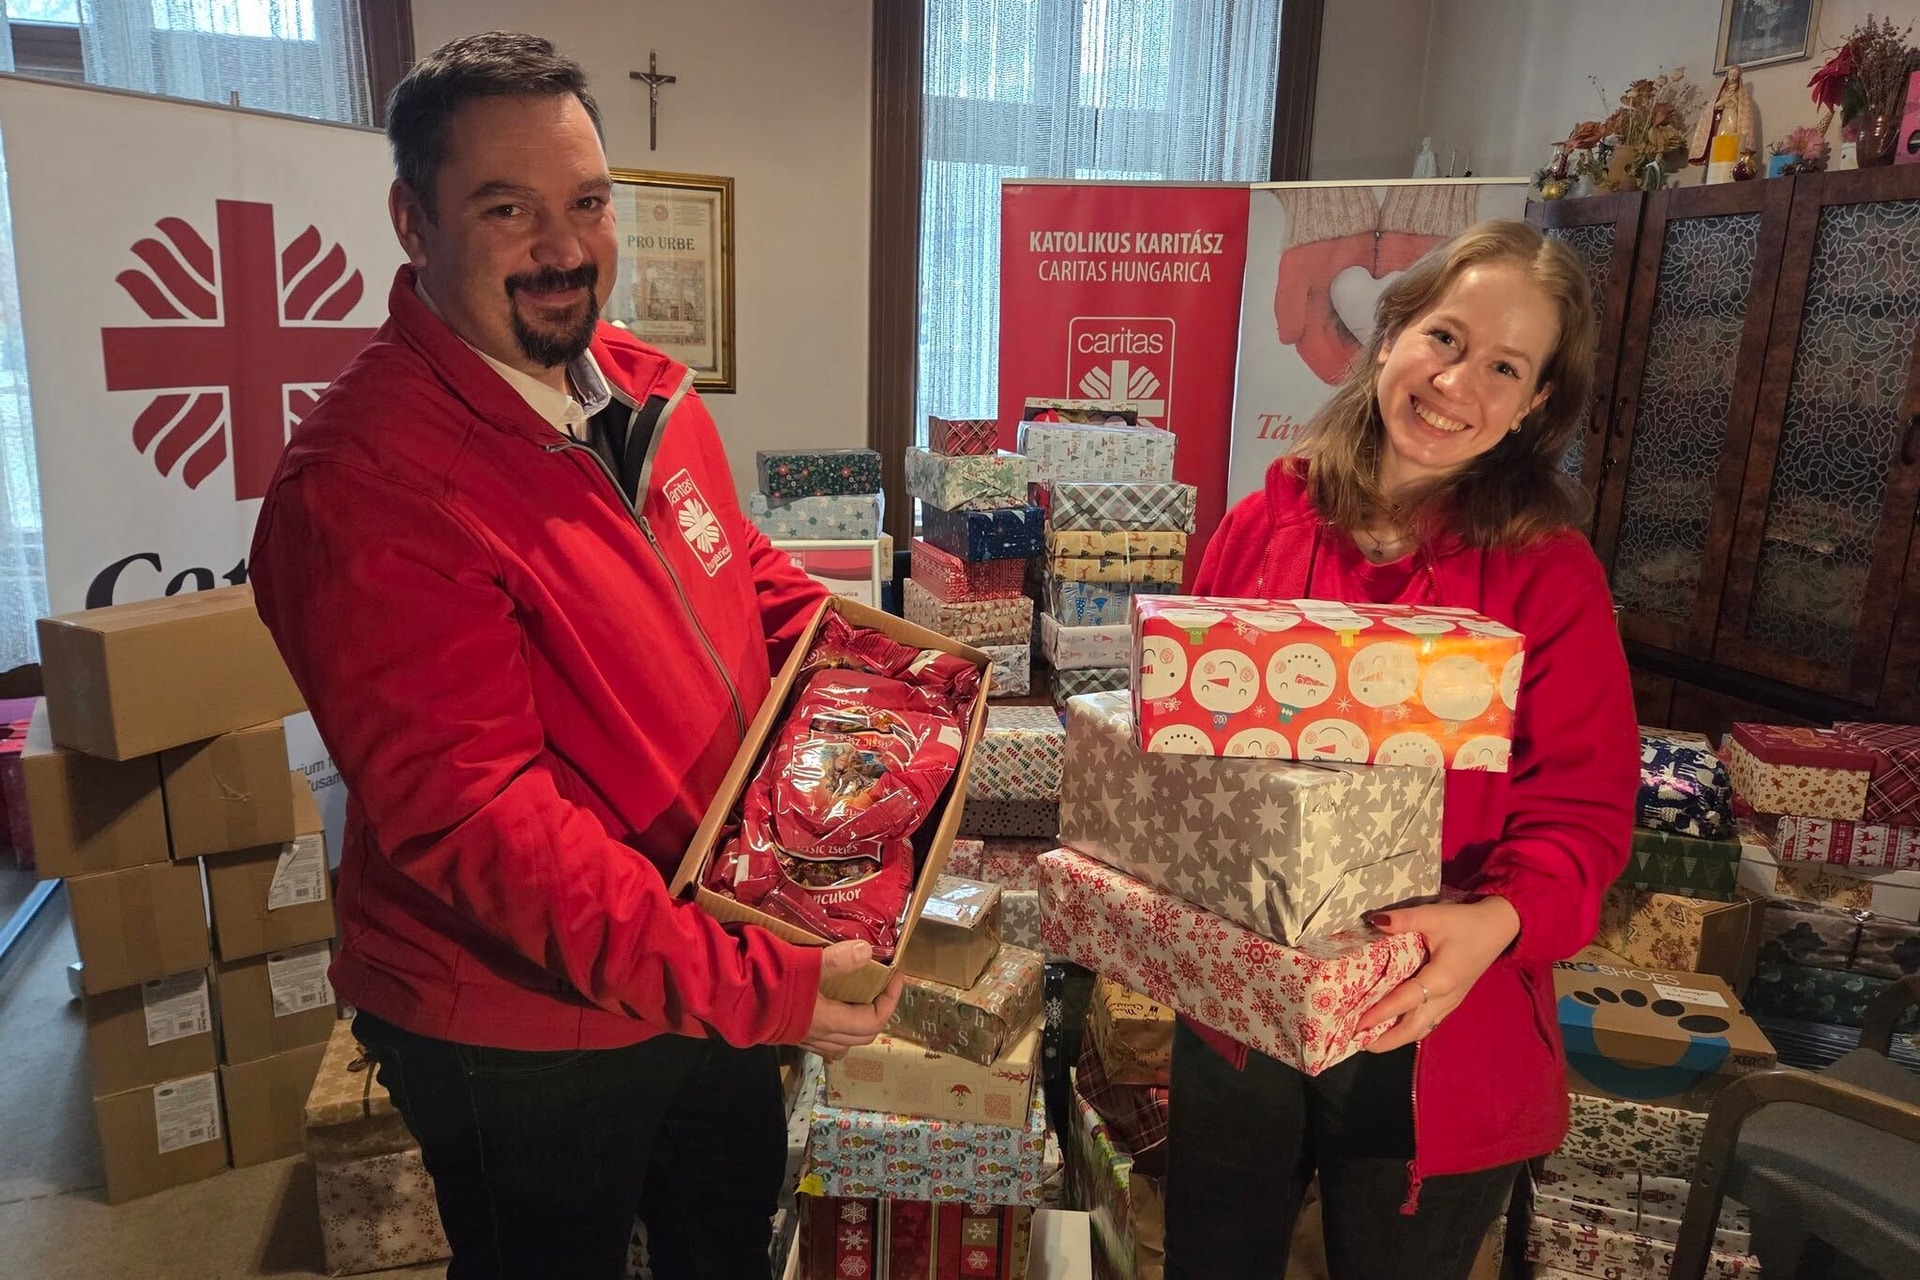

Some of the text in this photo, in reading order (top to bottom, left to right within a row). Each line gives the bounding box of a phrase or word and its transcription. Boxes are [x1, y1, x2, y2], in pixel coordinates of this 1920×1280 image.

[627, 235, 695, 250] PRO URBE
[1029, 229, 1224, 254] KATOLIKUS KARITÁSZ
[1038, 260, 1211, 283] CARITAS HUNGARICA
[1077, 327, 1164, 354] caritas
[669, 478, 693, 504] aritas
[1598, 965, 1681, 985] SHOES
